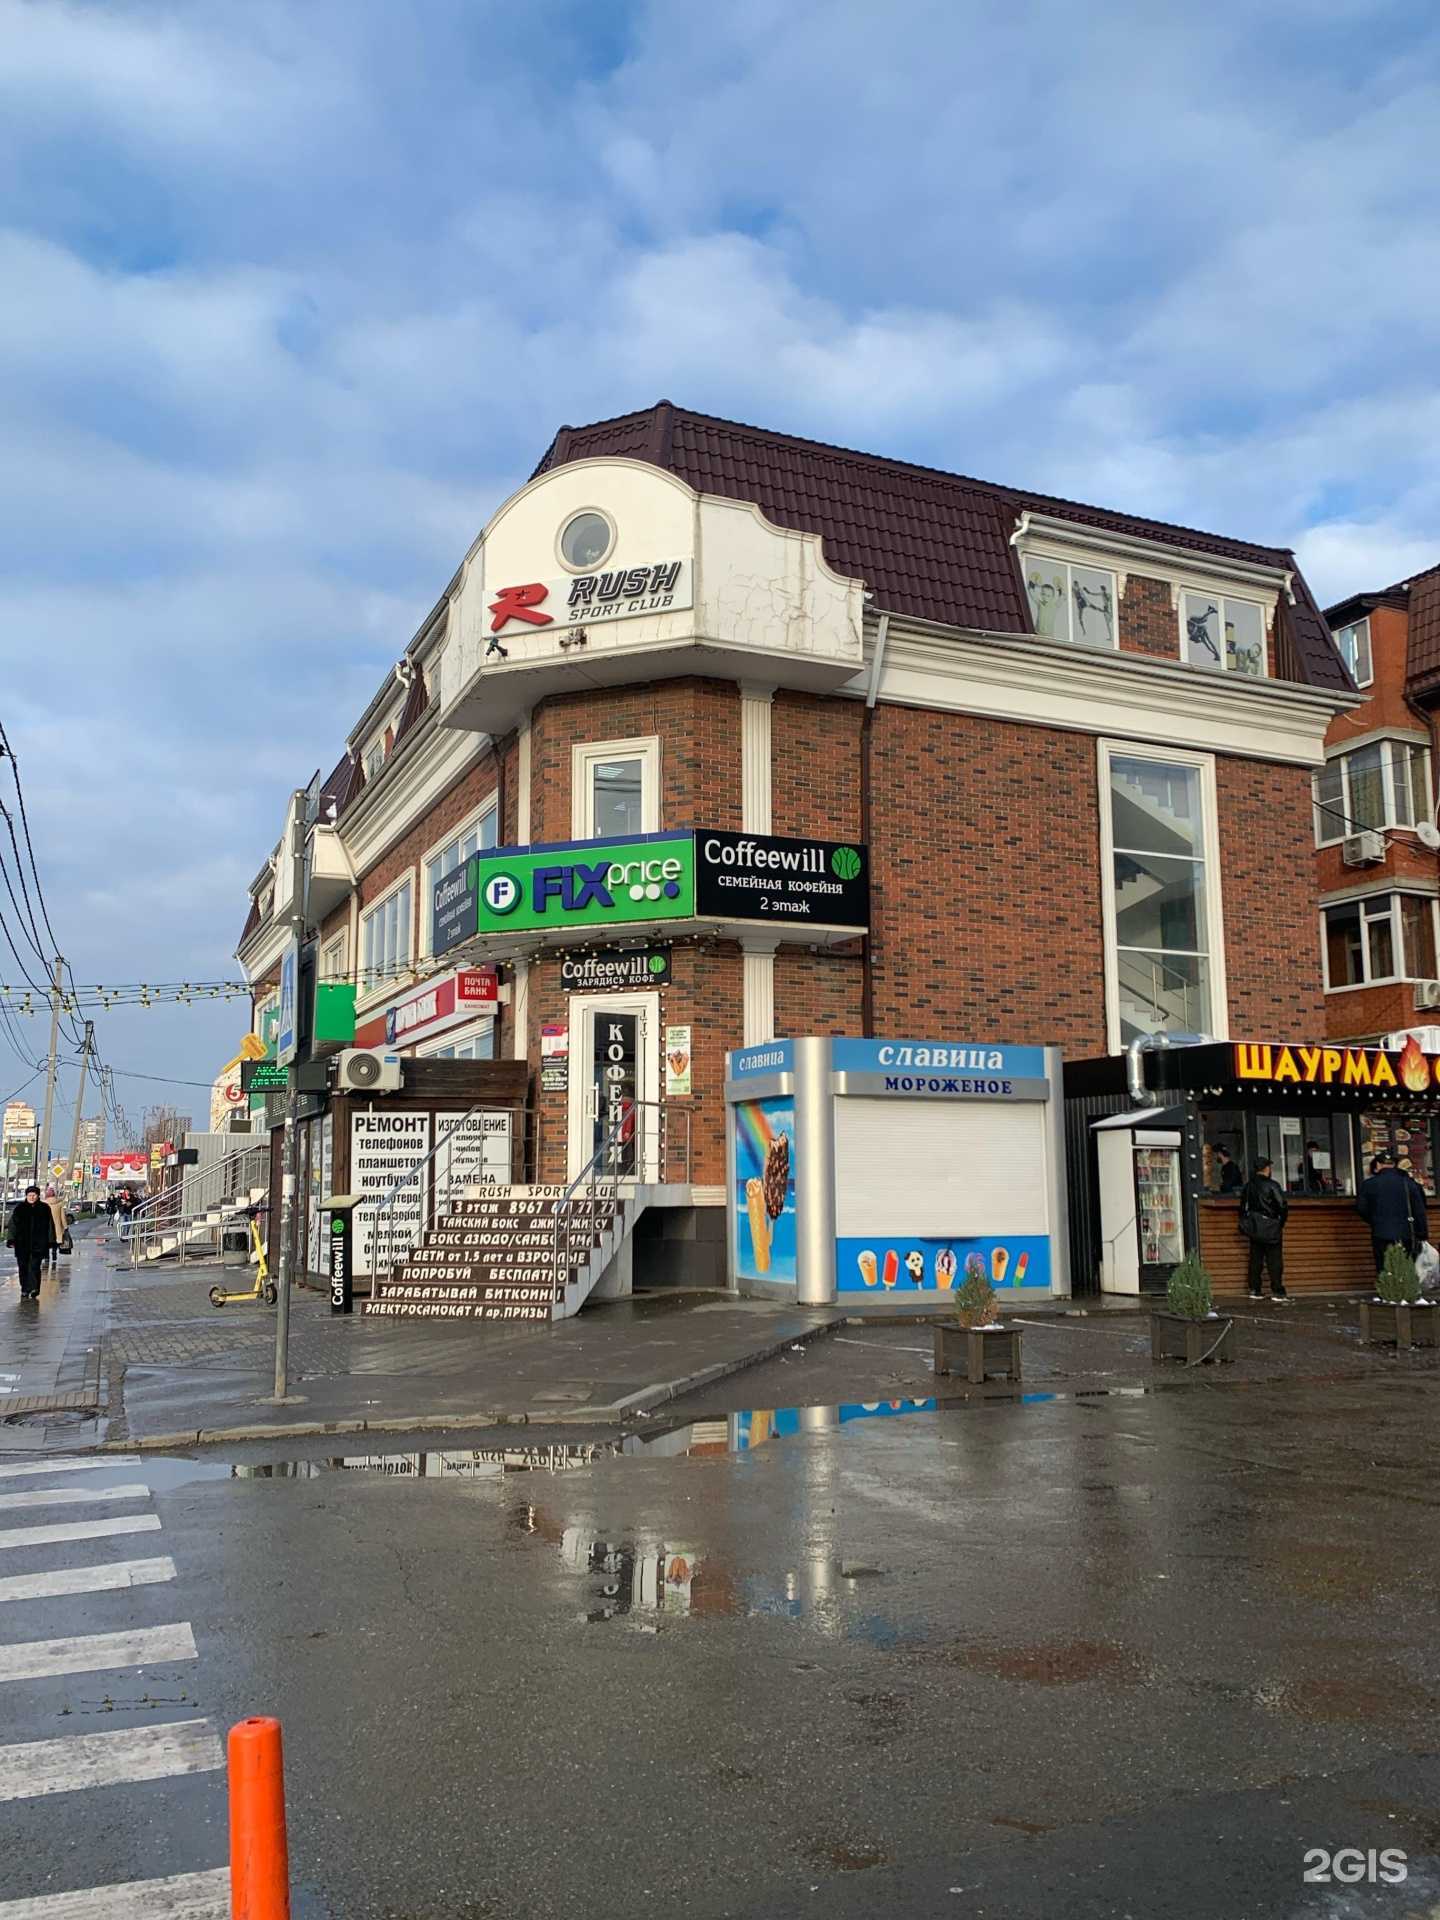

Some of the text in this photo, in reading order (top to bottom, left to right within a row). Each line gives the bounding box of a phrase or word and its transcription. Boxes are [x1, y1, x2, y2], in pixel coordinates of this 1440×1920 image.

[567, 561, 682, 606] RUSH
[568, 594, 674, 621] SPORT CLUB
[704, 839, 826, 873] Coffeewill
[607, 858, 681, 891] price
[718, 875, 843, 895] СЕМЕЙНАЯ КОФЕЙНЯ
[493, 882, 509, 905] F
[760, 896, 811, 914] 2 этаж
[562, 956, 649, 979] Coffeewill
[464, 977, 491, 987] ПОЧТА
[577, 974, 655, 987] ЗАРЯДИСЬ КОФЕ
[464, 987, 488, 996] БАНК
[739, 1049, 785, 1072] славица
[878, 1046, 1003, 1070] славица
[1236, 1044, 1398, 1087] ШАУРМА
[885, 1076, 1013, 1095] МОРОЖЕНОЕ
[354, 1117, 428, 1132] РЕМОНТ
[359, 1137, 423, 1151] телефонов
[358, 1157, 423, 1169] планшетов
[448, 1174, 496, 1185] ЗАМЕНА
[361, 1193, 421, 1204] омпьтеро
[479, 1186, 513, 1198] RUSH
[528, 1186, 568, 1197] SPORT
[455, 1201, 462, 1213] 3
[466, 1202, 499, 1214] этаж
[509, 1201, 544, 1214] 8967
[442, 1216, 489, 1228] ТАЙСКИЙ
[491, 1217, 519, 1229] БОКС
[428, 1231, 461, 1245] БОКС
[412, 1250, 444, 1262] ДЕТИ
[448, 1253, 461, 1262] от
[464, 1251, 480, 1263] 1.5
[482, 1253, 502, 1263] лет
[506, 1254, 513, 1262] и
[332, 1237, 344, 1306] Coffeewill
[402, 1266, 472, 1280] ПОПРОБУЙ
[381, 1286, 478, 1300] ЗАРАБАТЫВАЙ
[365, 1304, 471, 1317] ЭЛЕКТРОСАМОКАТ
[474, 1306, 483, 1316] И
